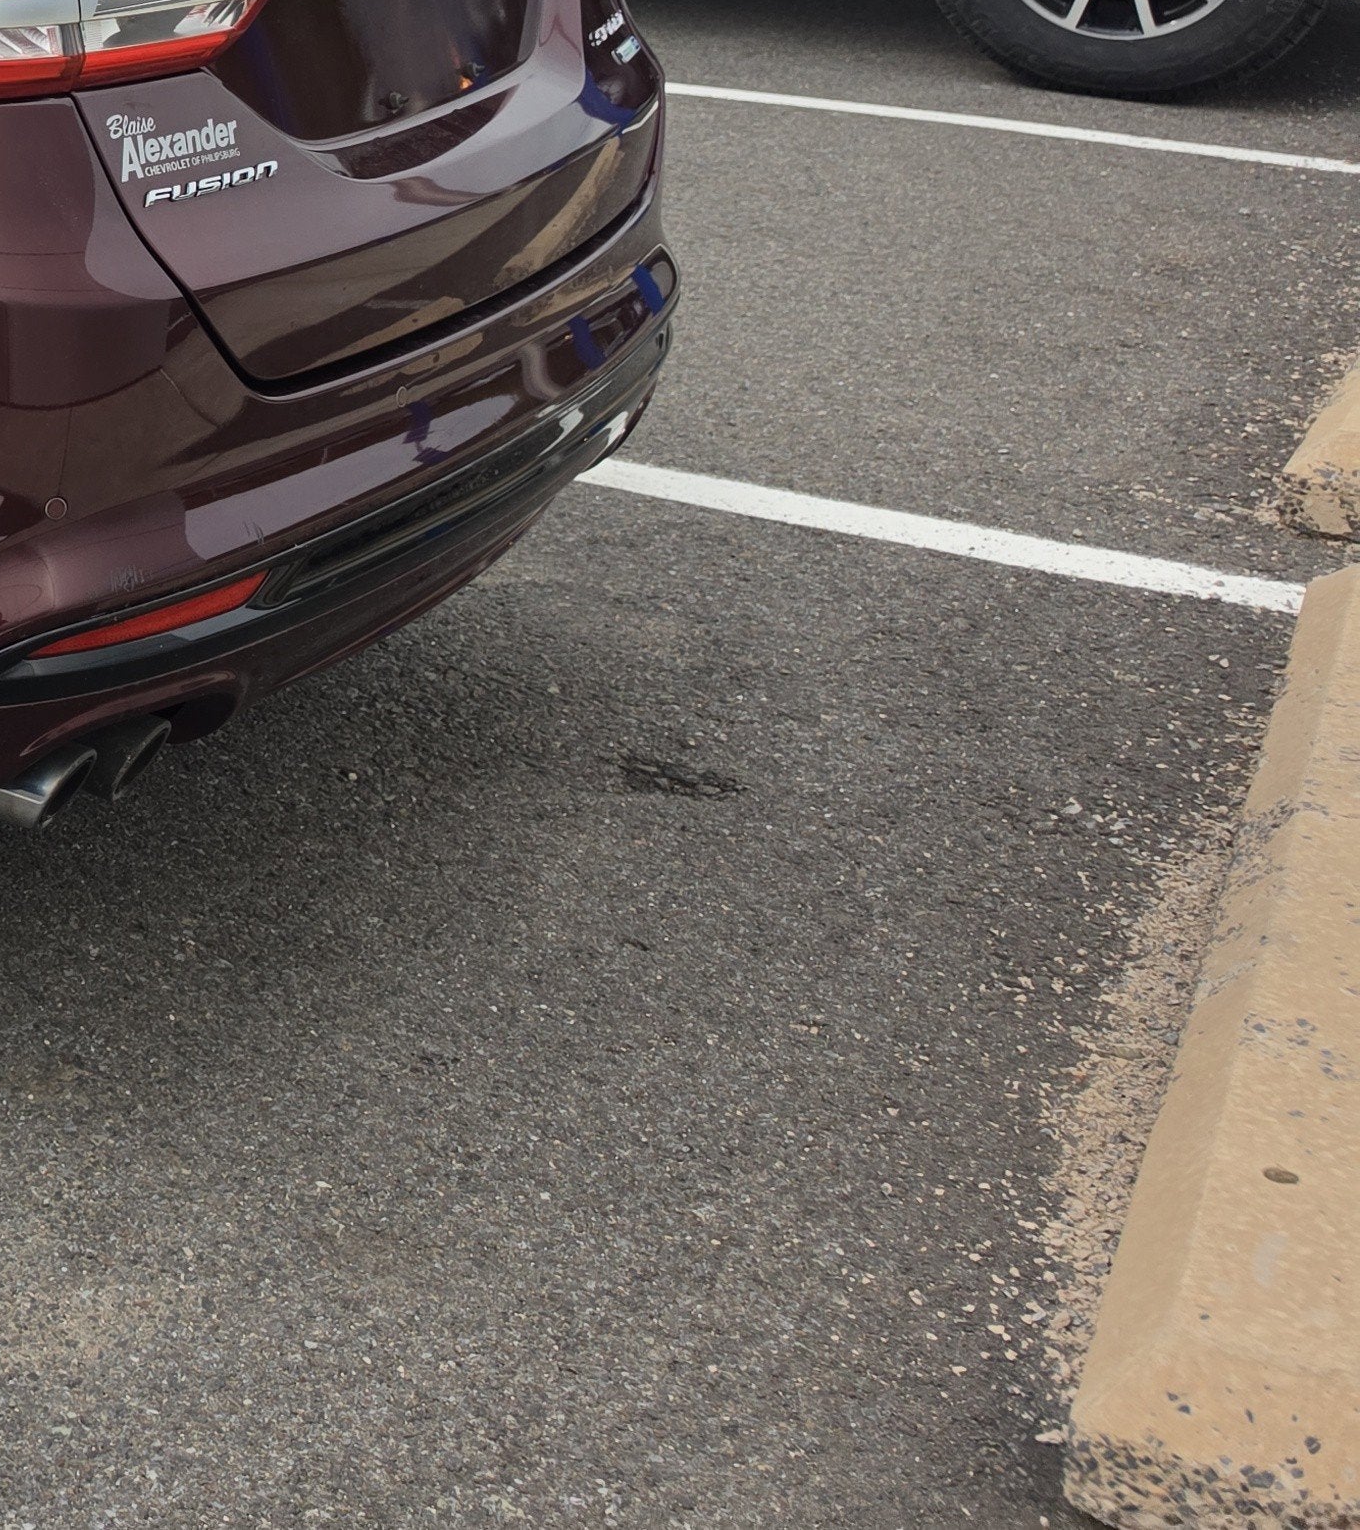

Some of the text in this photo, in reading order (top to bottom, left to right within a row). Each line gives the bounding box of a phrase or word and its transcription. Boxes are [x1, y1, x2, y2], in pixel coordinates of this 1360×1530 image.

[106, 114, 156, 139] Blaise
[121, 118, 237, 183] Alexander
[144, 157, 190, 177] CHEVROLET
[191, 155, 201, 166] OF
[144, 160, 279, 208] FUSION
